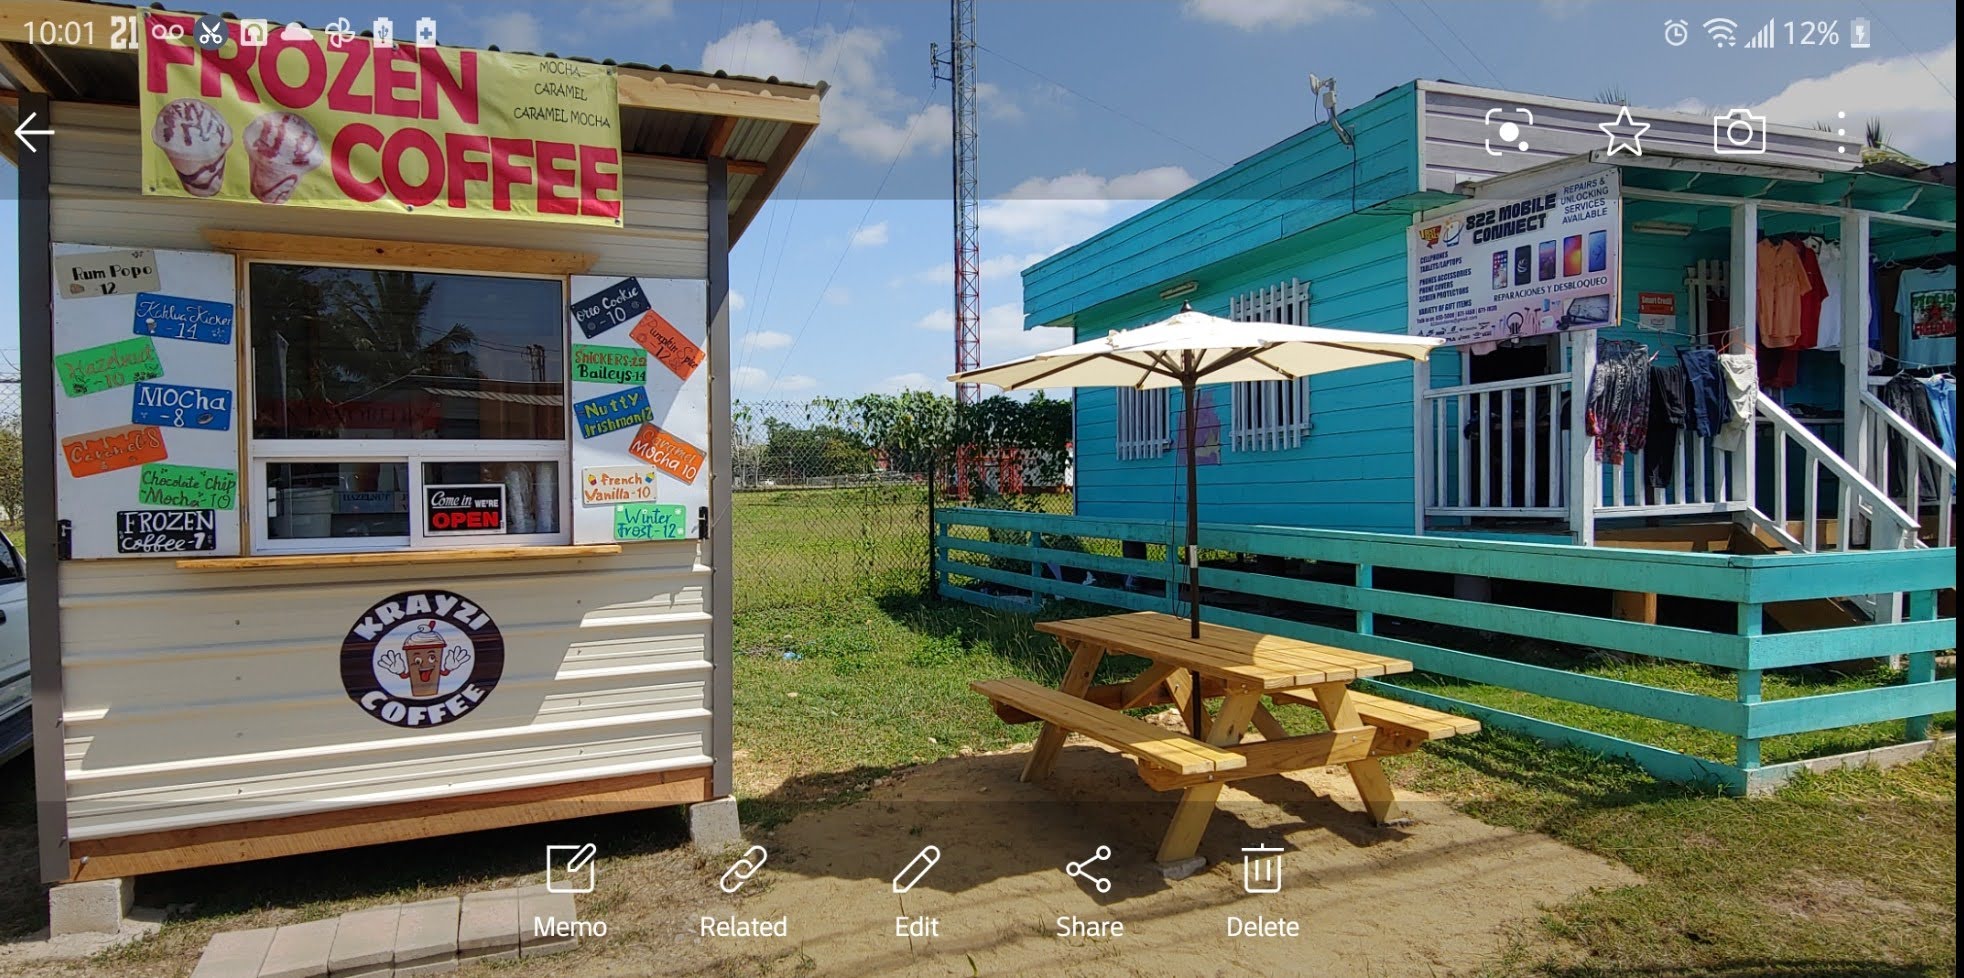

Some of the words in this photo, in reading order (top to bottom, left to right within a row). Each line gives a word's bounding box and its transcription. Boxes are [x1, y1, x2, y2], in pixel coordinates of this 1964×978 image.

[144, 12, 479, 125] FROZEN
[539, 61, 581, 77] MOCHA
[534, 83, 588, 101] CARAMEL
[513, 107, 568, 123] CARAMEL
[570, 111, 611, 128] MOCHA
[331, 122, 621, 219] COFFEE
[1560, 186, 1609, 206] UNLOCKING
[1563, 179, 1598, 195] REPAIRS
[1465, 209, 1496, 231] 822
[1499, 193, 1557, 221] MOBILE
[1562, 207, 1608, 225] AVAILABLE
[1564, 198, 1606, 215] SERVICES
[1473, 213, 1547, 244] CONNECT
[72, 267, 106, 281] Rum
[109, 264, 153, 279] Popo
[602, 287, 639, 310] Cookie
[1494, 288, 1545, 302] REPARACIONES
[1547, 285, 1552, 293] Y
[1553, 276, 1608, 292] DESBLOQUEO
[642, 429, 696, 463] Caramel
[142, 470, 200, 489] Chocolate
[682, 464, 697, 480] 10
[431, 490, 460, 506] Come
[461, 494, 472, 506] in
[474, 499, 499, 508] WE'RE
[123, 510, 214, 534] FROZEN
[432, 511, 499, 529] OPEN
[624, 508, 672, 525] Winter
[354, 593, 490, 641] KRAYZI
[360, 683, 485, 726] COFFEE
